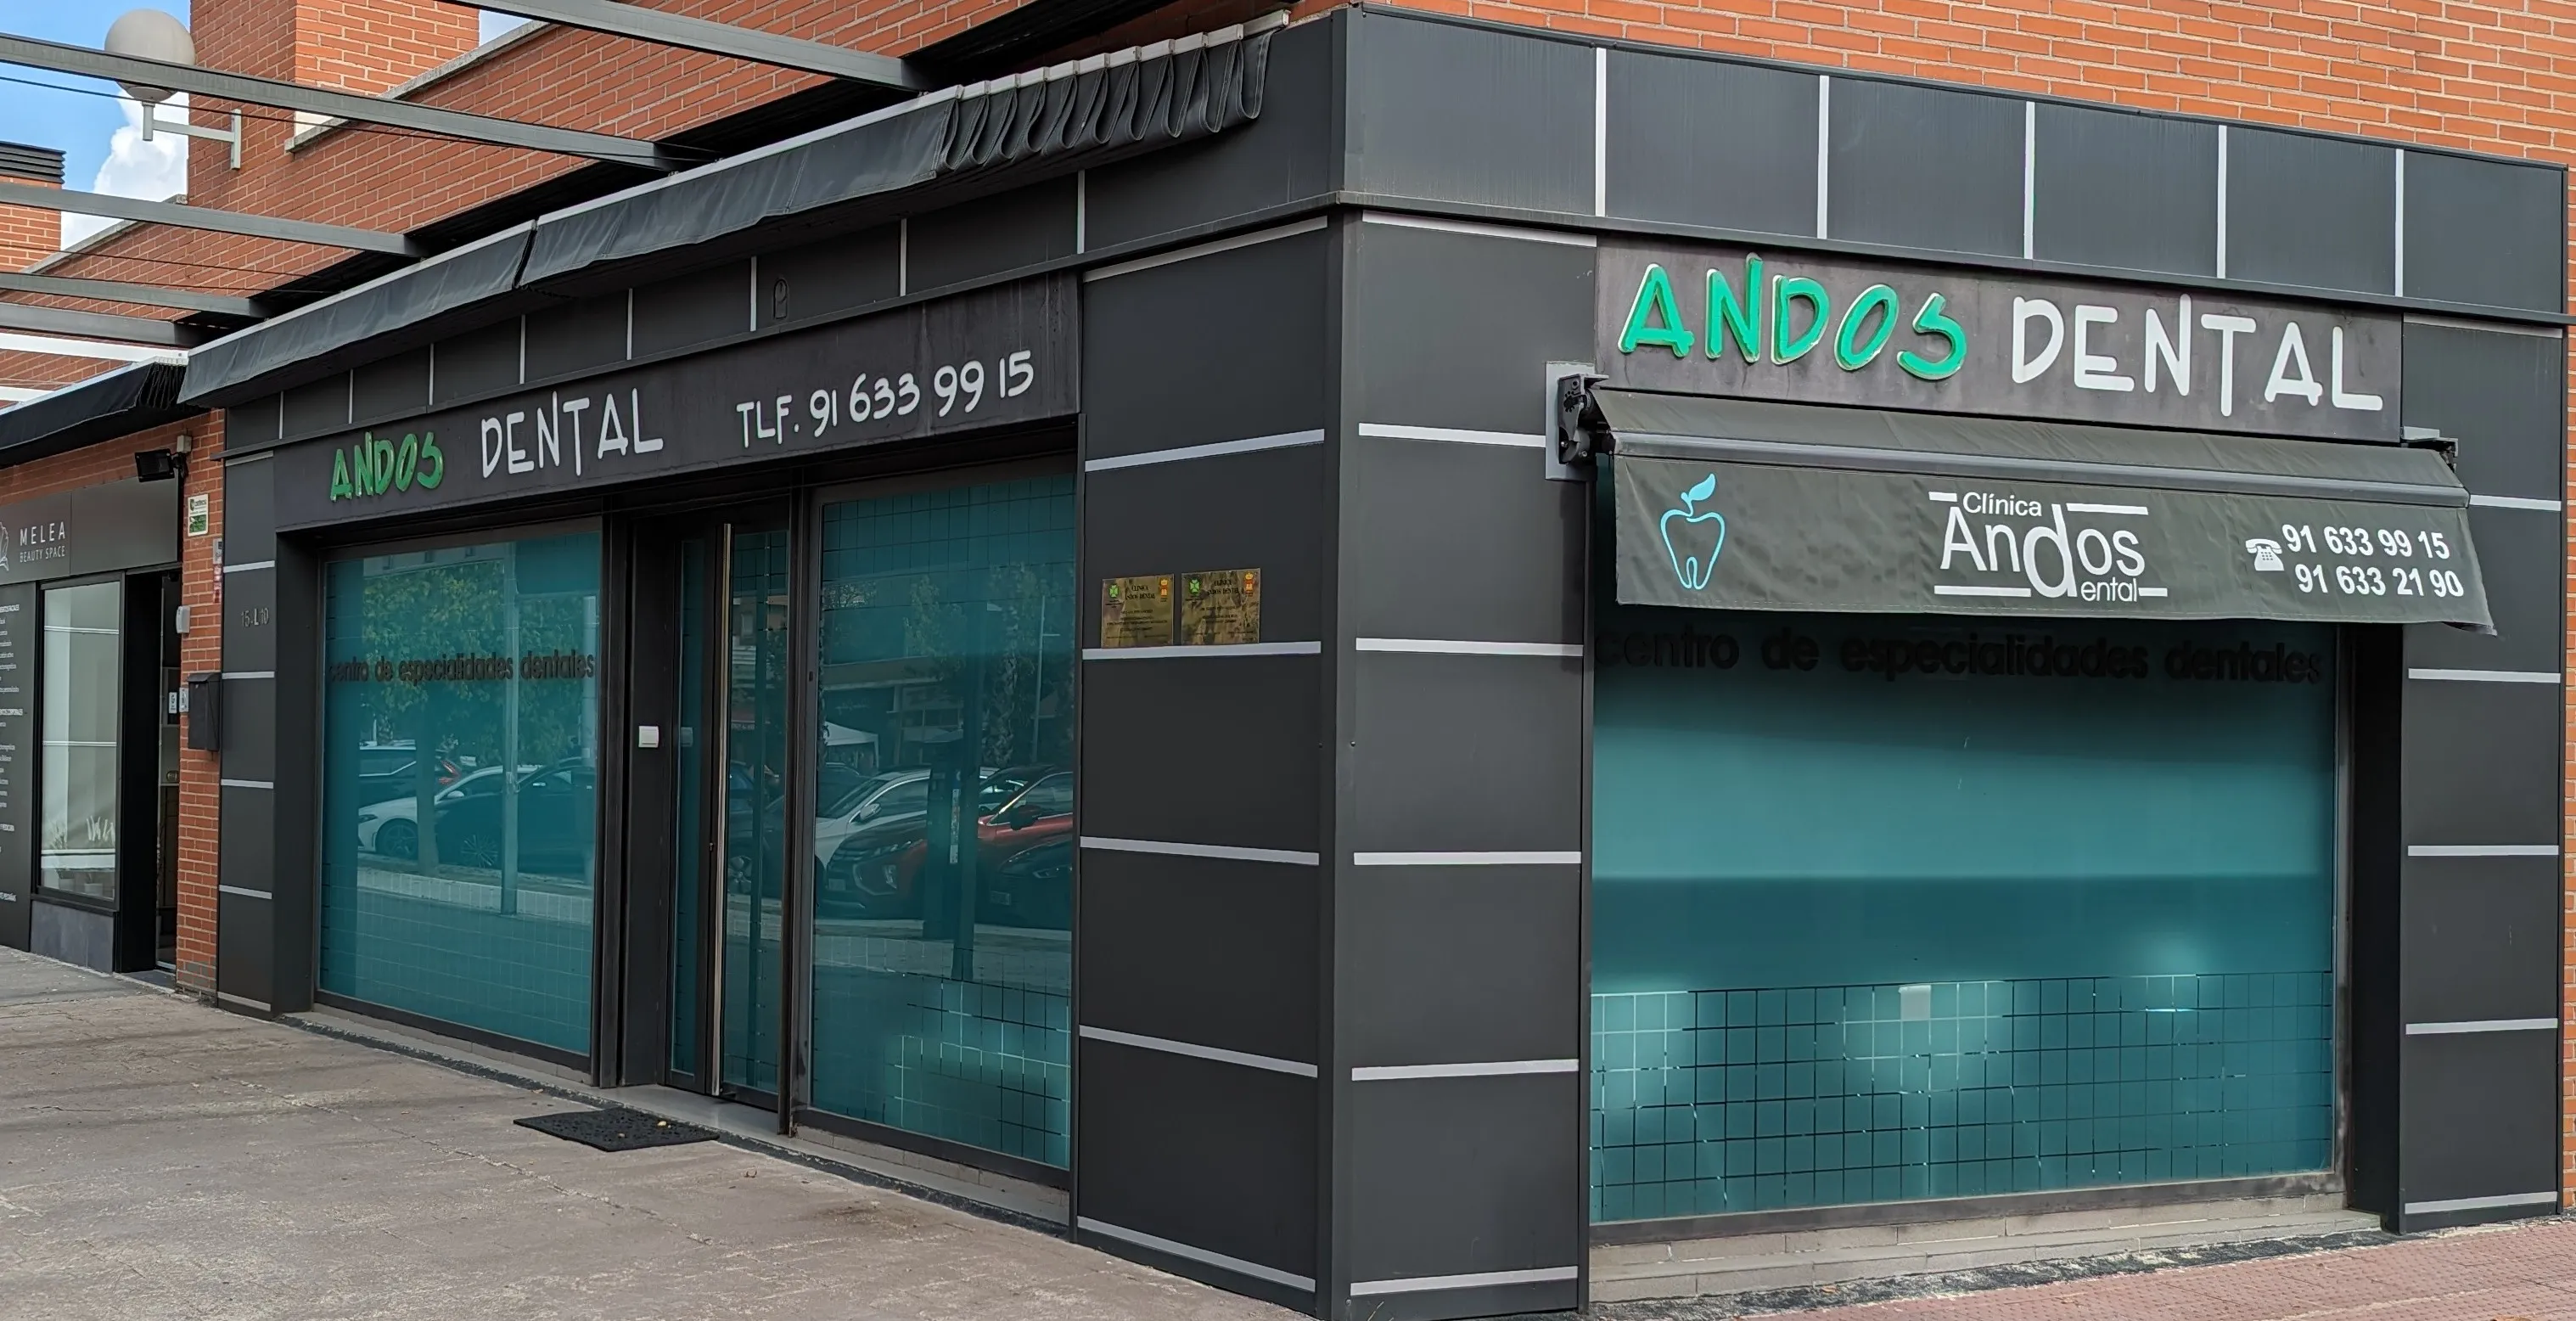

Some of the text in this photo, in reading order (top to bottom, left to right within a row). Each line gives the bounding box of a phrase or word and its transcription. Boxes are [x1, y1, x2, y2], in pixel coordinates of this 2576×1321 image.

[1618, 252, 2383, 416] ANDOS DENTAL
[330, 350, 1034, 502] ANDOS DENTAL TLF. 91 633 99 15
[1962, 492, 2042, 517] Clínica
[20, 521, 65, 546] MELEA
[1939, 503, 2146, 598] Andos
[2281, 524, 2450, 559] 91 633 99 15
[20, 546, 65, 563] BEAUTY SPACE
[2294, 564, 2464, 598] 91 633 21 90
[329, 649, 594, 686] centro de especialidades dentales
[1595, 623, 2322, 685] centro de especialidades dentales
